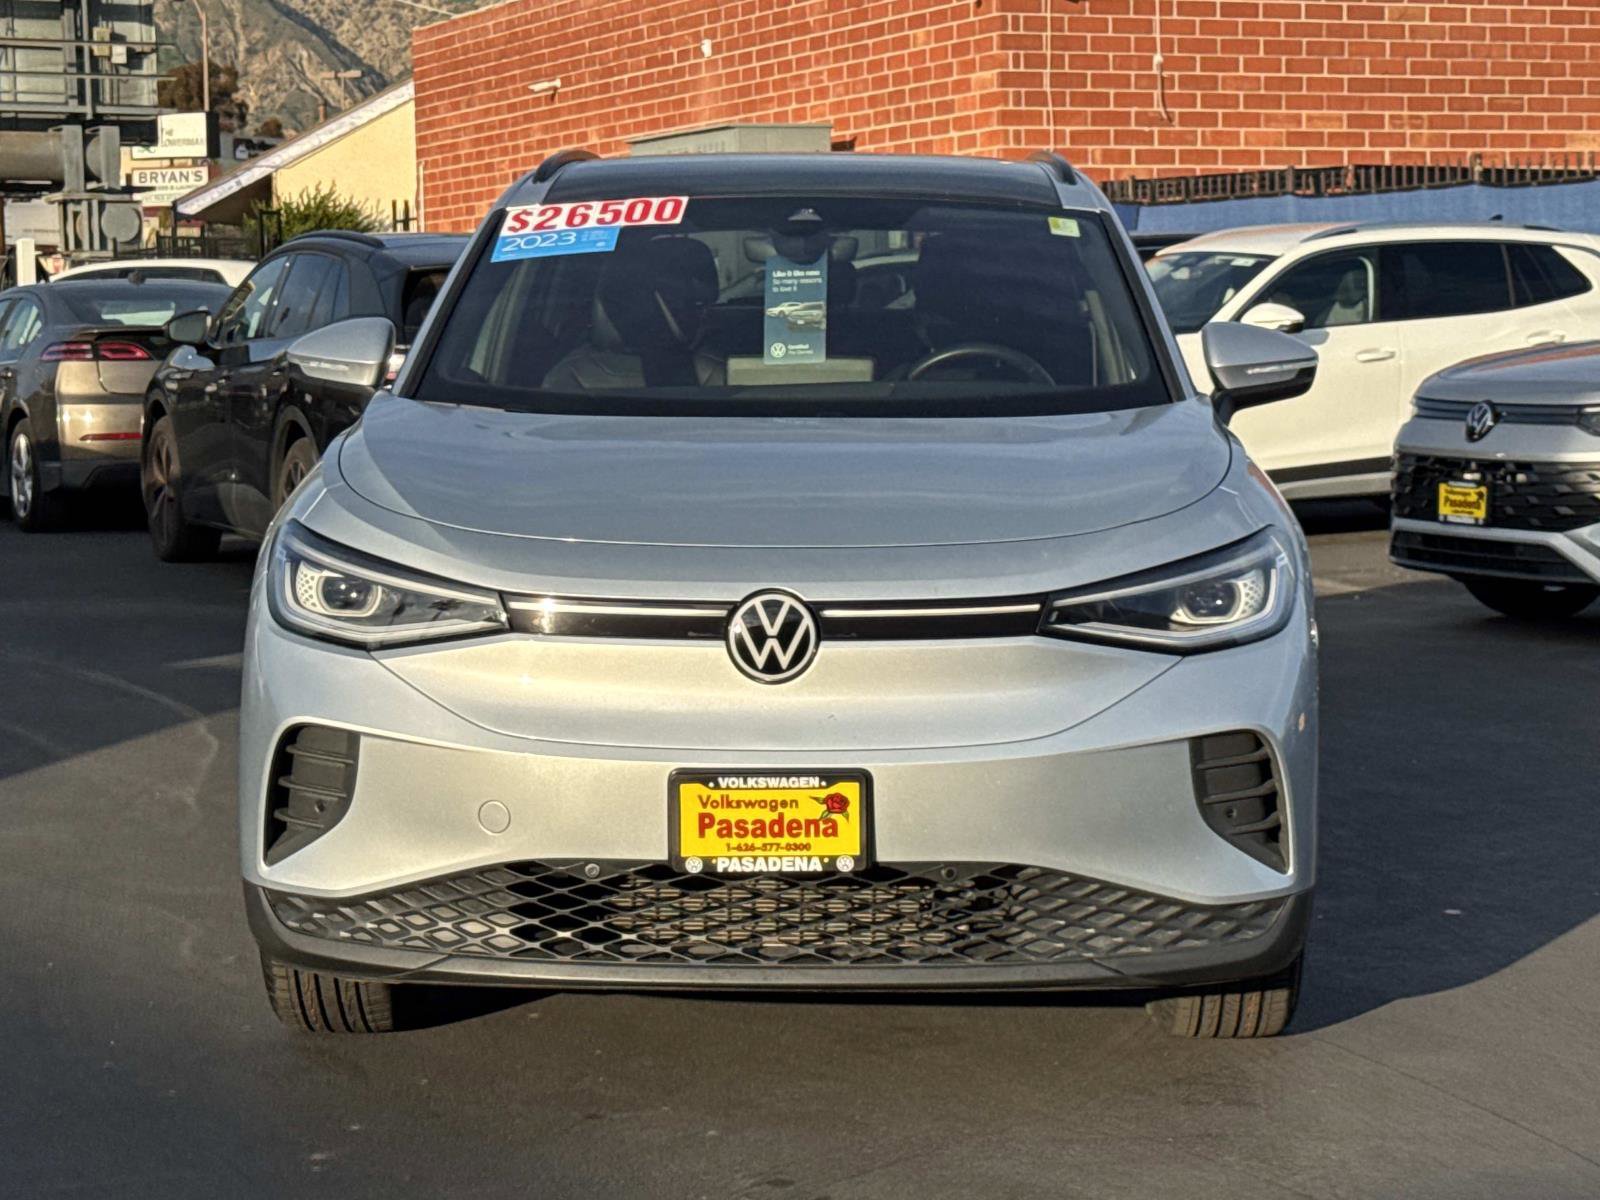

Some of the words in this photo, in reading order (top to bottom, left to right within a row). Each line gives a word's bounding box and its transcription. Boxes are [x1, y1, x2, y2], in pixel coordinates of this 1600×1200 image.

[138, 170, 204, 184] BRYAN'S
[507, 197, 684, 233] $26500
[501, 232, 577, 252] 2023
[717, 776, 820, 788] VOLKSWAGEN
[697, 794, 800, 812] Volkswagen
[697, 812, 839, 838] Pasadena
[716, 855, 823, 872] PASADENA
